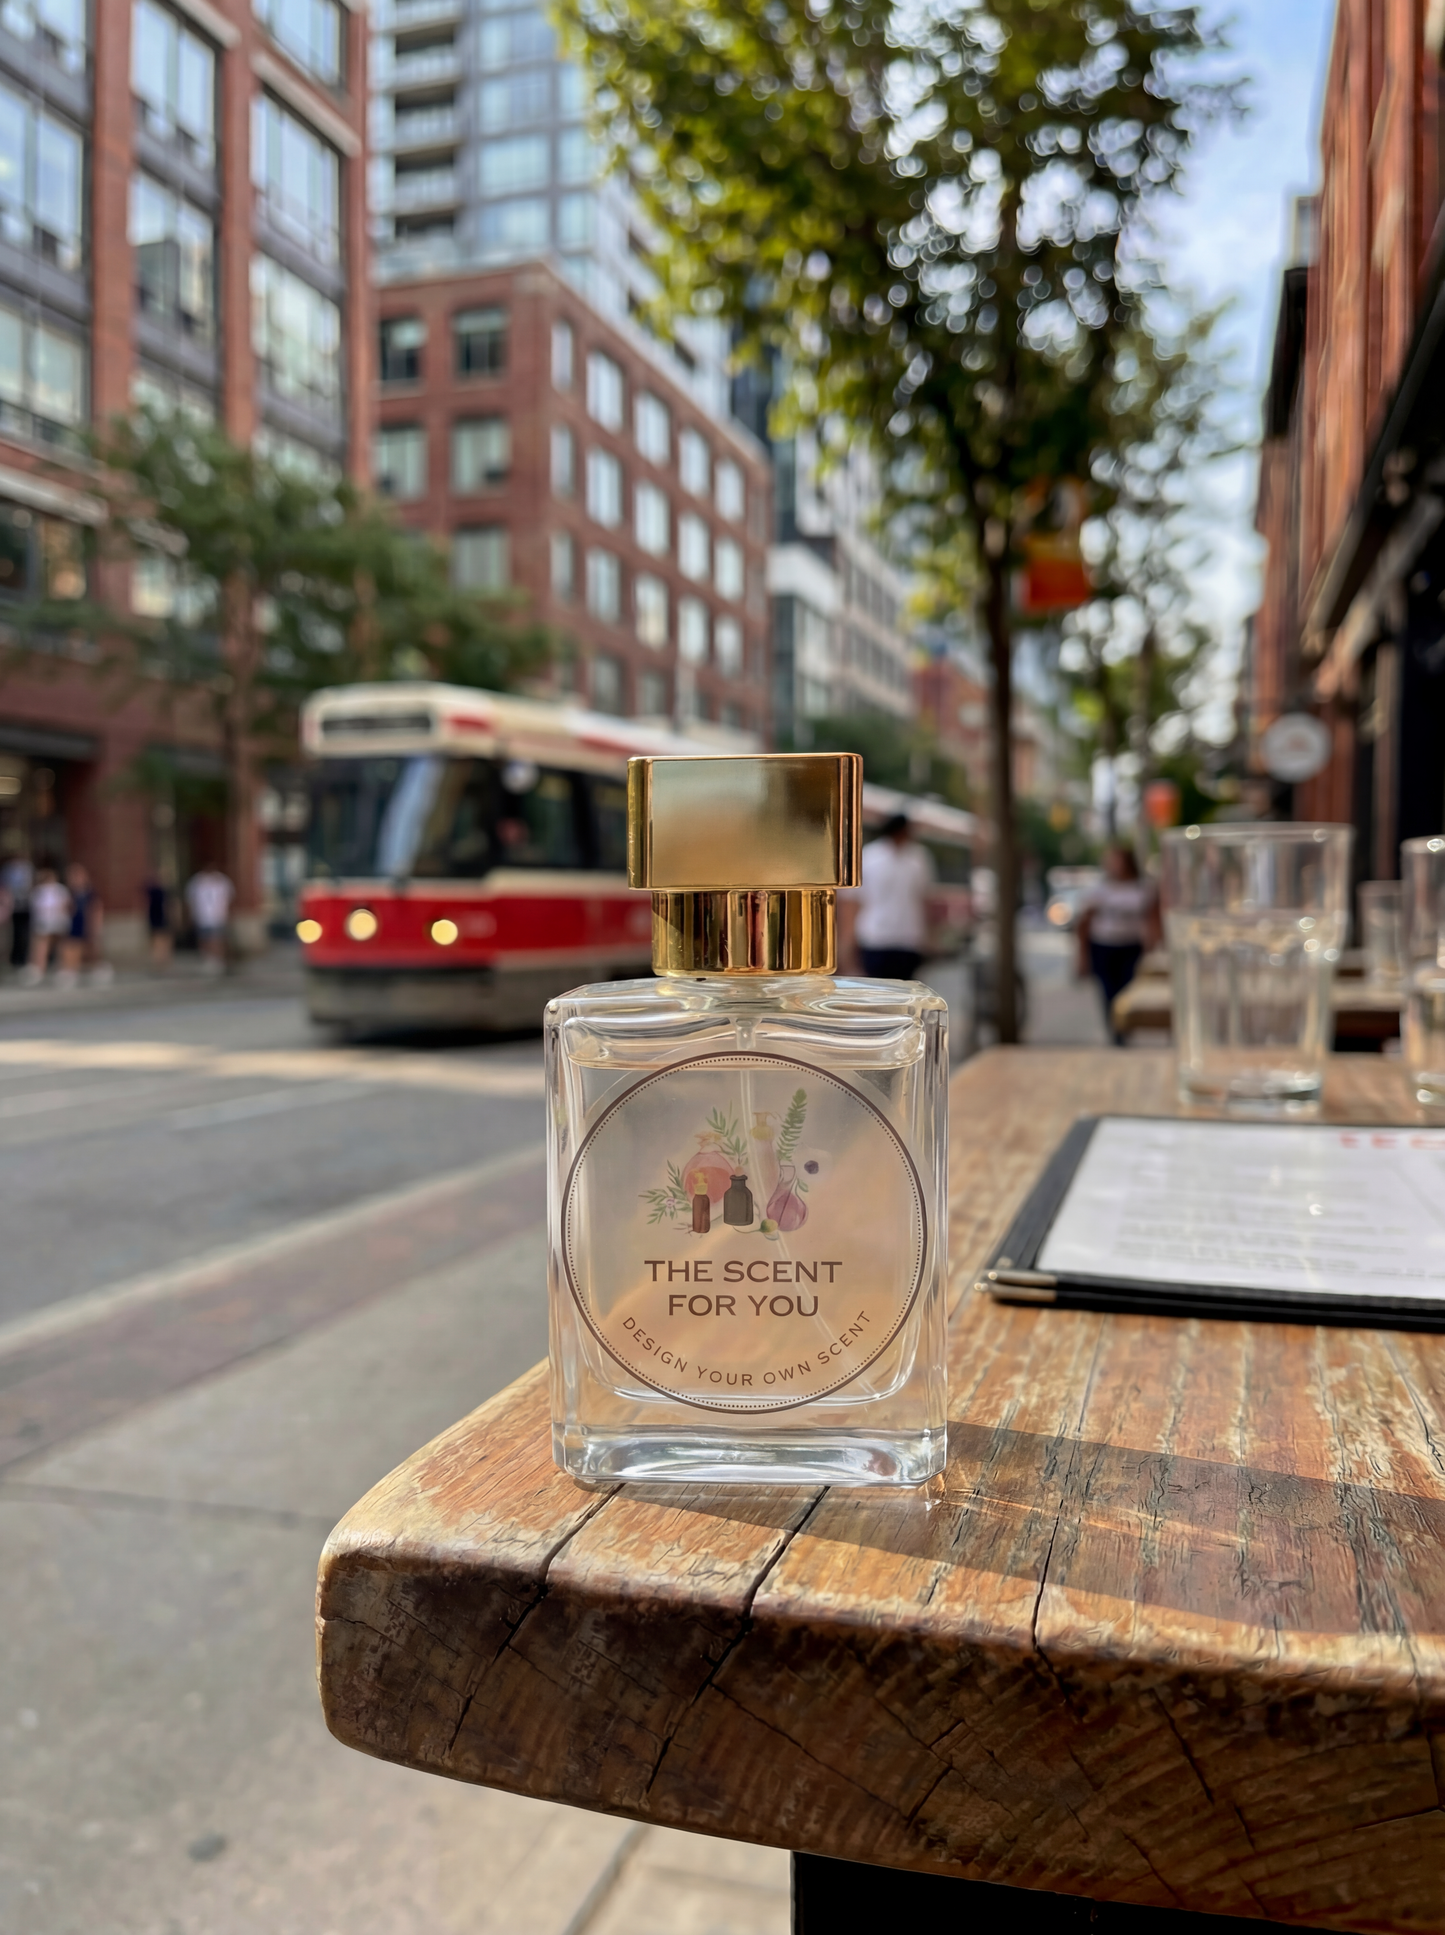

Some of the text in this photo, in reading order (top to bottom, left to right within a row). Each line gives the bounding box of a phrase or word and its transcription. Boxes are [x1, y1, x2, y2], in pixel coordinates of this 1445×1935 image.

[644, 1260, 843, 1283] THE SCENT
[668, 1294, 819, 1317] FOR YOU
[622, 1310, 871, 1386] DESIGN YOUR OWN SCENT
